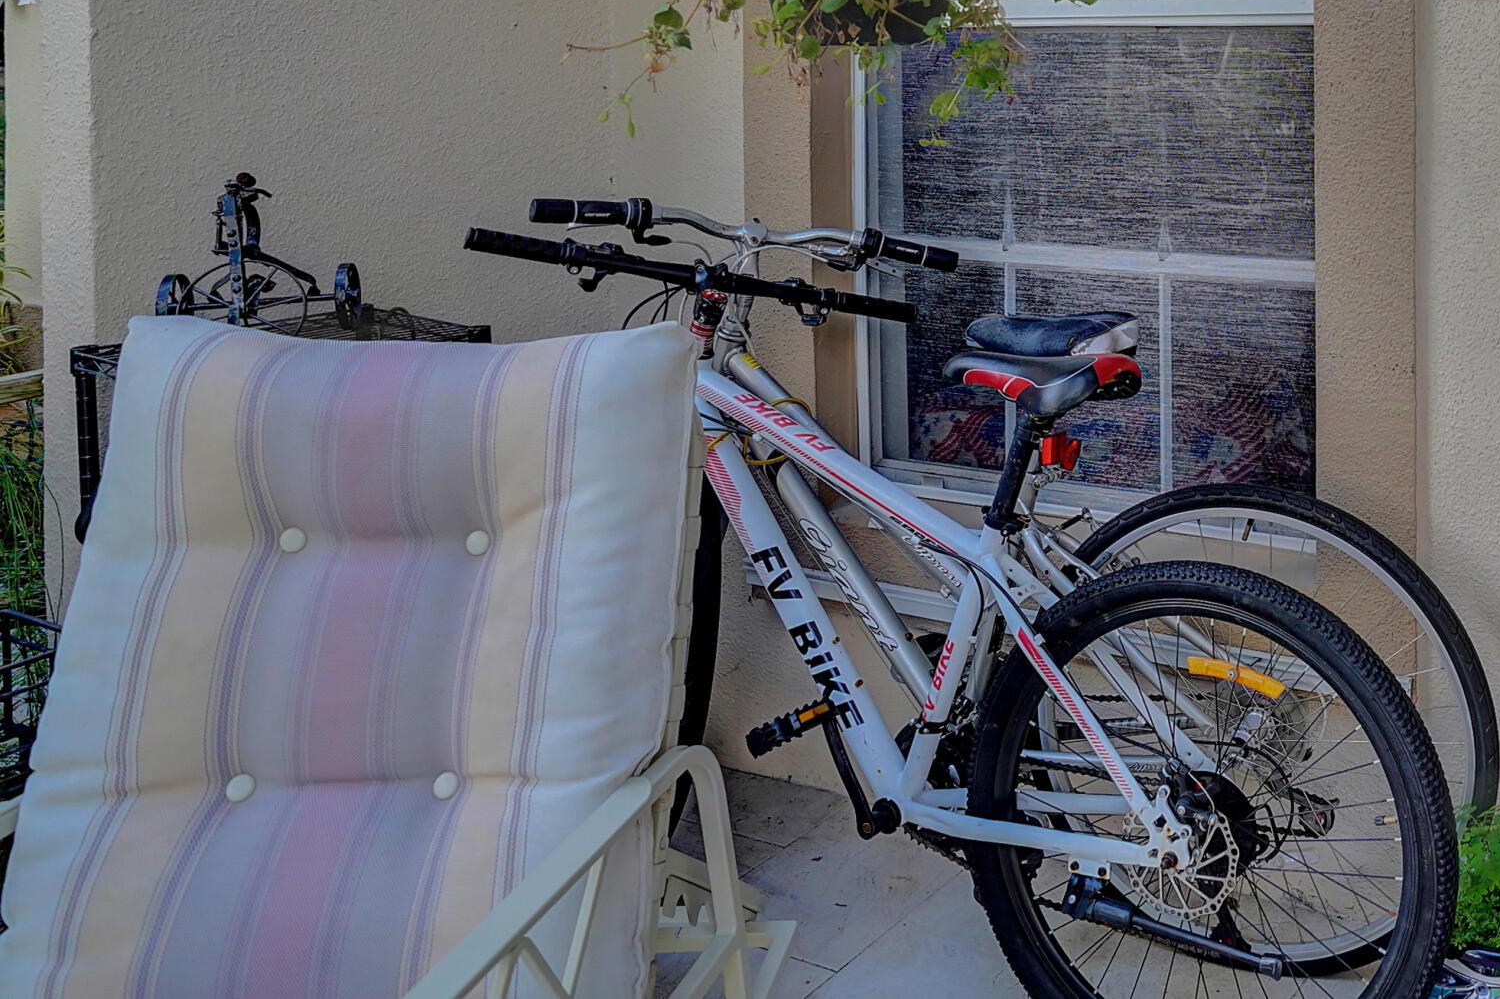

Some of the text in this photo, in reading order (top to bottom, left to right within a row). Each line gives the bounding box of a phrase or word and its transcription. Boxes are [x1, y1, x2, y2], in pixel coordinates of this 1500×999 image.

[733, 393, 836, 452] FV BIKE
[751, 546, 865, 732] FV BIKE
[799, 517, 899, 652] Giant
